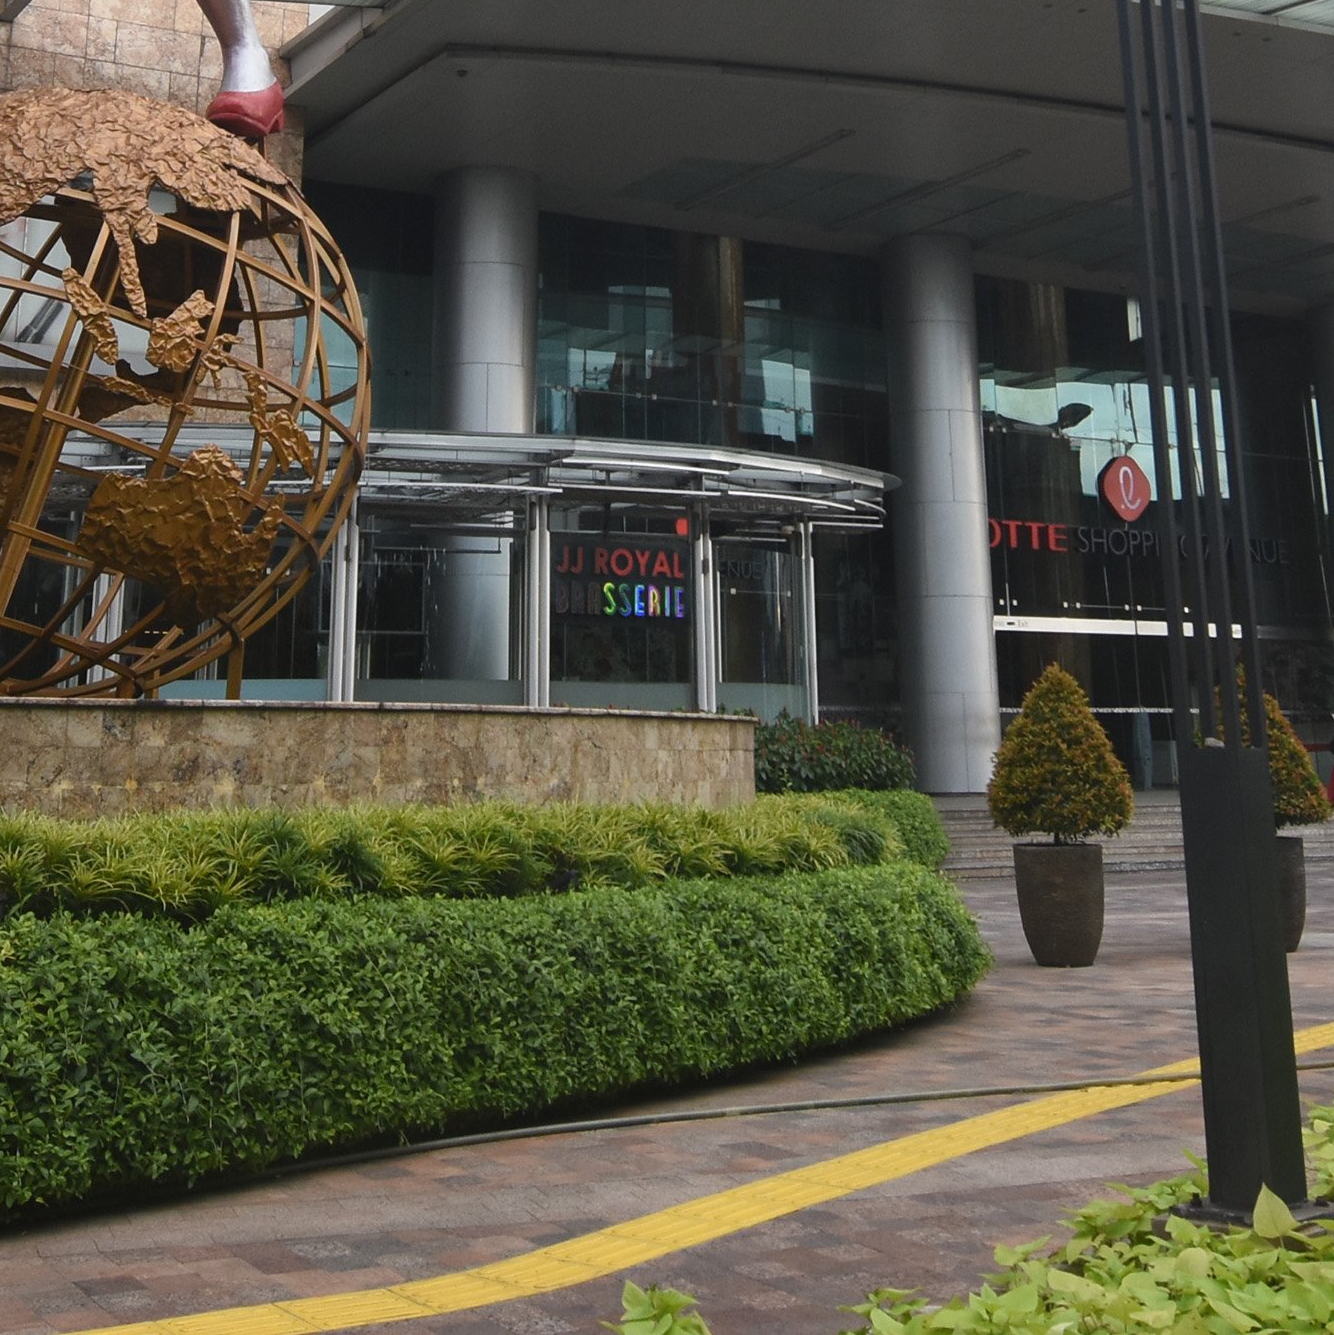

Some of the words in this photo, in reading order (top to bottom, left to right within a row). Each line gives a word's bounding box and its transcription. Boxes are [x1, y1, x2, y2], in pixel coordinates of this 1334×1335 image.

[988, 518, 1068, 552] OTTE
[556, 546, 584, 573] JJ
[595, 546, 684, 578] ROYAL
[555, 581, 685, 618] BRASSERIE
